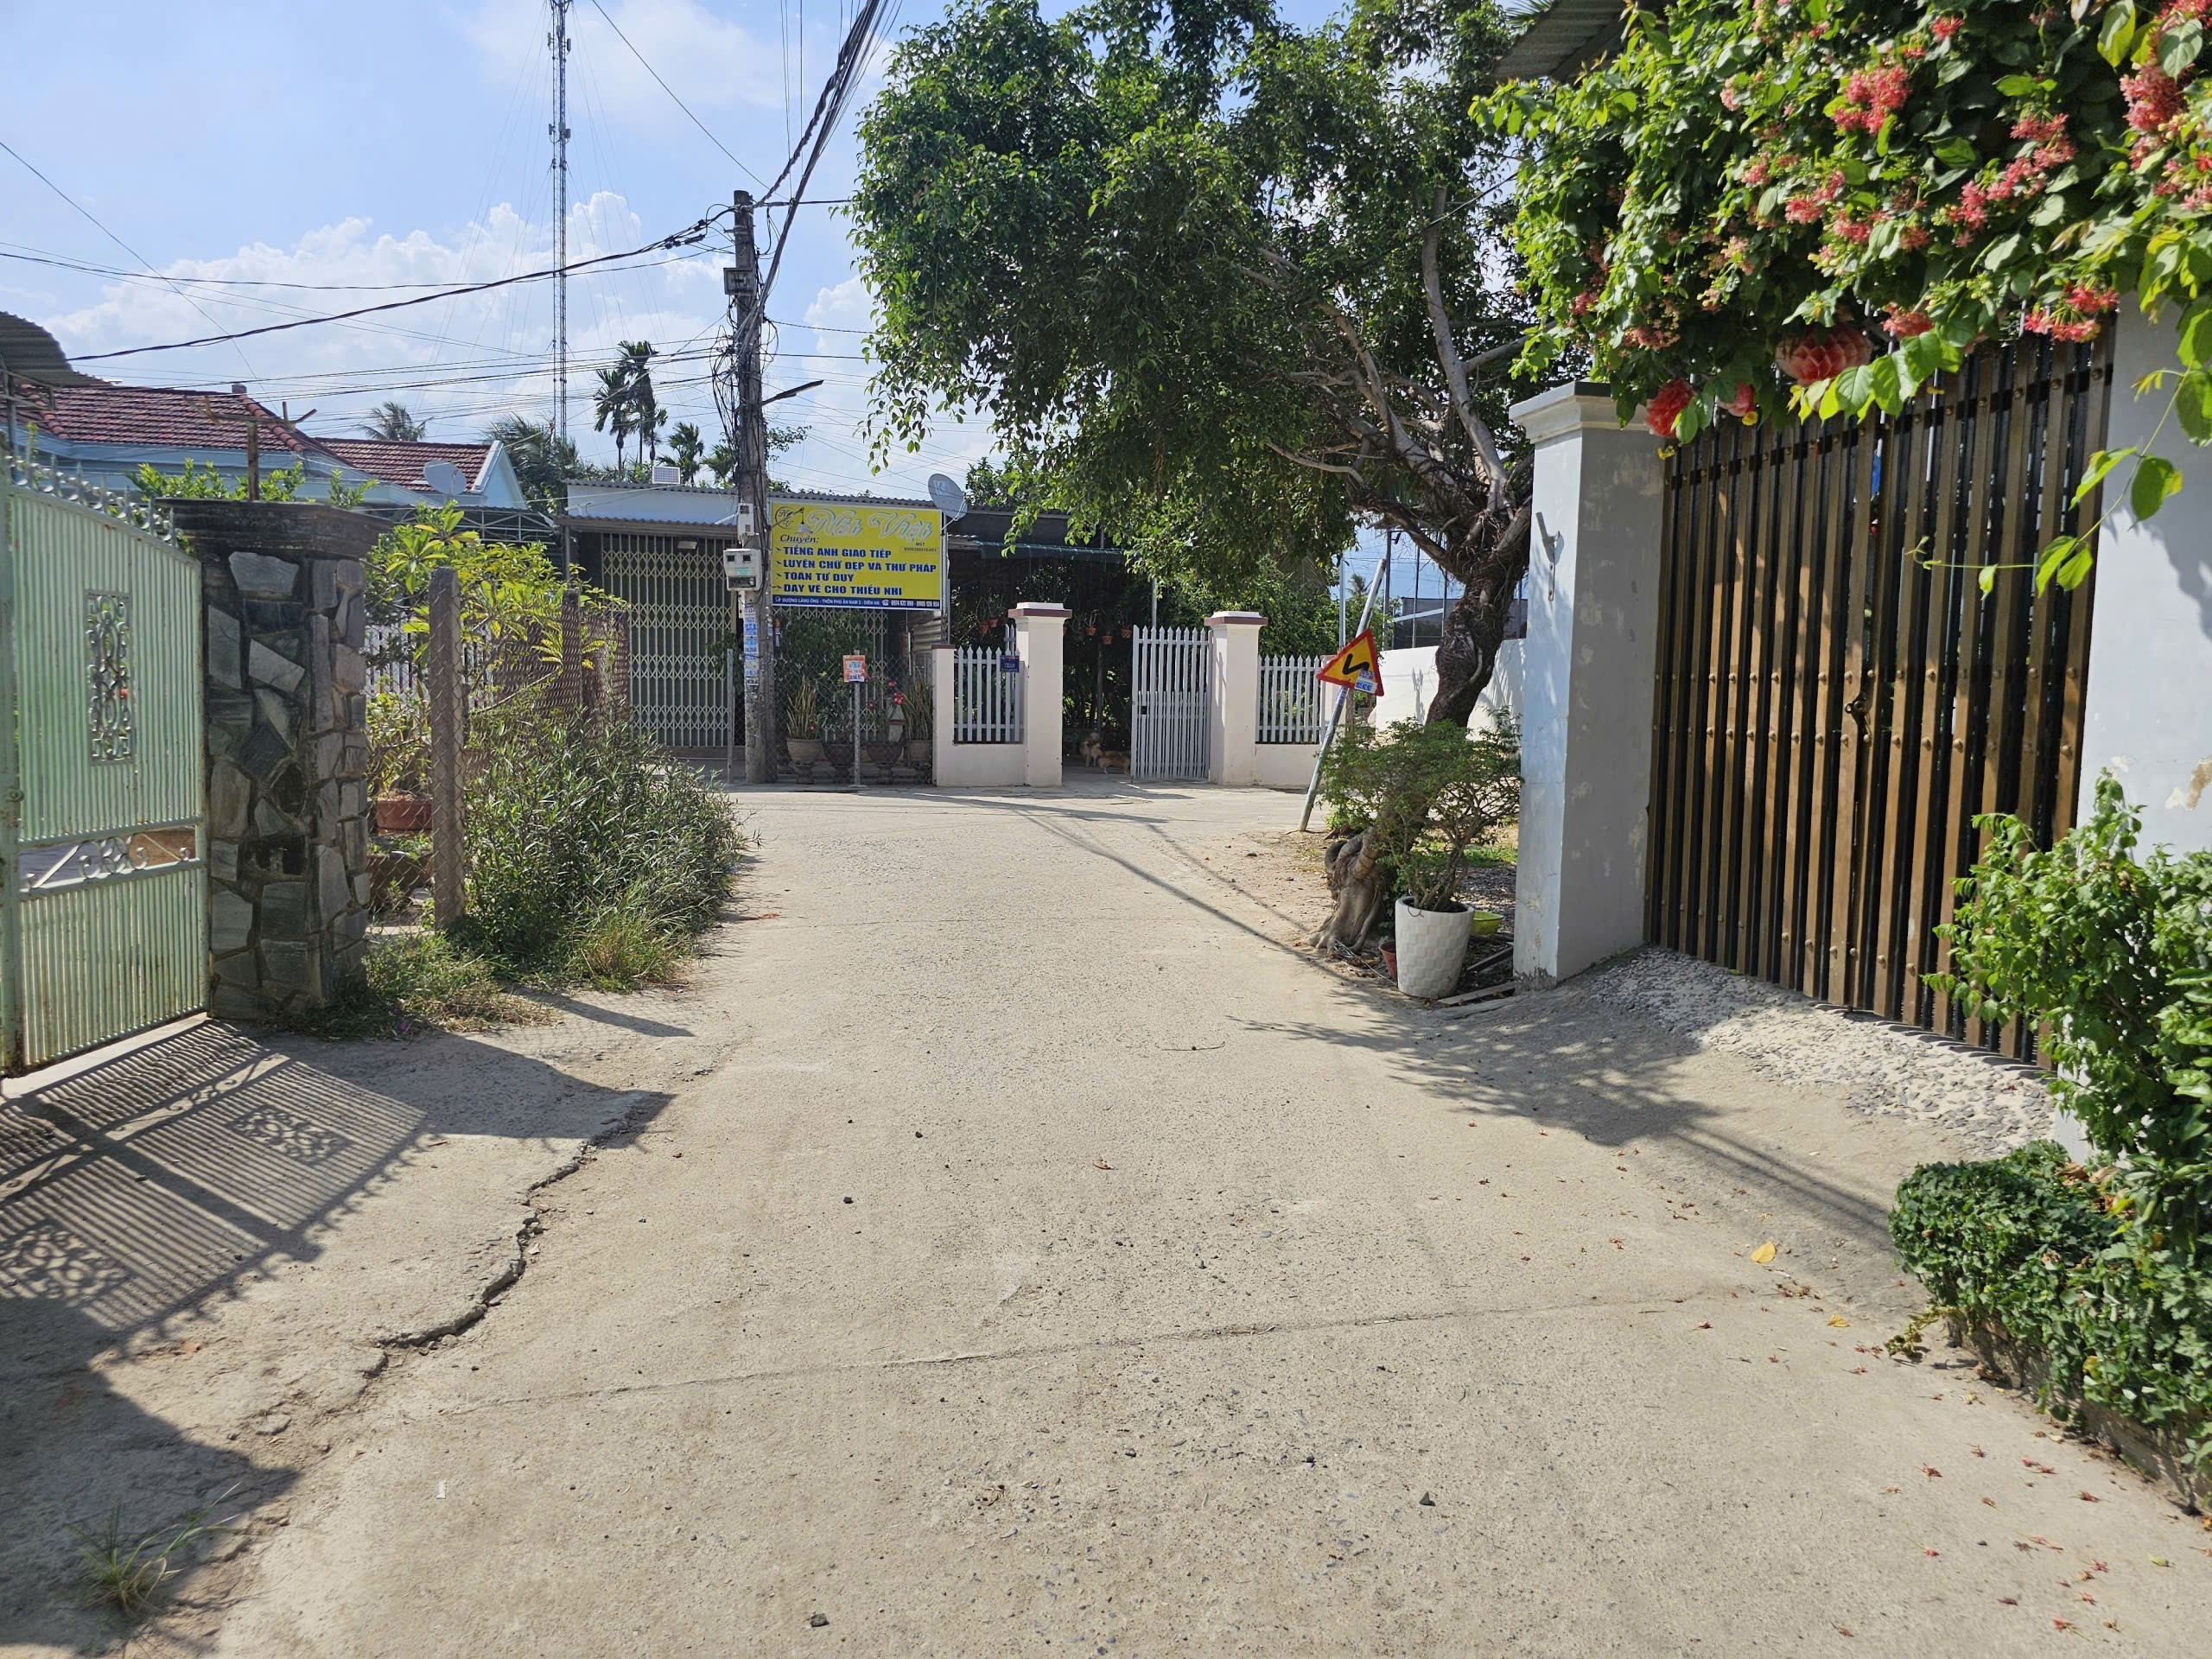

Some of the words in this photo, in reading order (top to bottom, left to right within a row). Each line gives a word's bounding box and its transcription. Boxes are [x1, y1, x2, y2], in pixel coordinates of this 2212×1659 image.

[780, 534, 820, 544] Chuyên:
[783, 544, 814, 556] TIẾNG
[817, 548, 838, 556] ANH
[842, 549, 866, 558] GIAO
[869, 548, 892, 558] TIẾP
[783, 559, 816, 569] LUYỆN
[818, 560, 842, 569] CHỮ
[844, 562, 865, 572] ĐẸP
[868, 562, 881, 571] VÀ
[885, 563, 907, 571] THƯ
[909, 563, 937, 573] PHÁP
[816, 572, 830, 582] TƯ
[833, 574, 855, 582] DUY
[784, 584, 804, 594] DẠY
[824, 585, 847, 594] CHO
[850, 584, 880, 595] THIẾU
[884, 588, 902, 596] NHI
